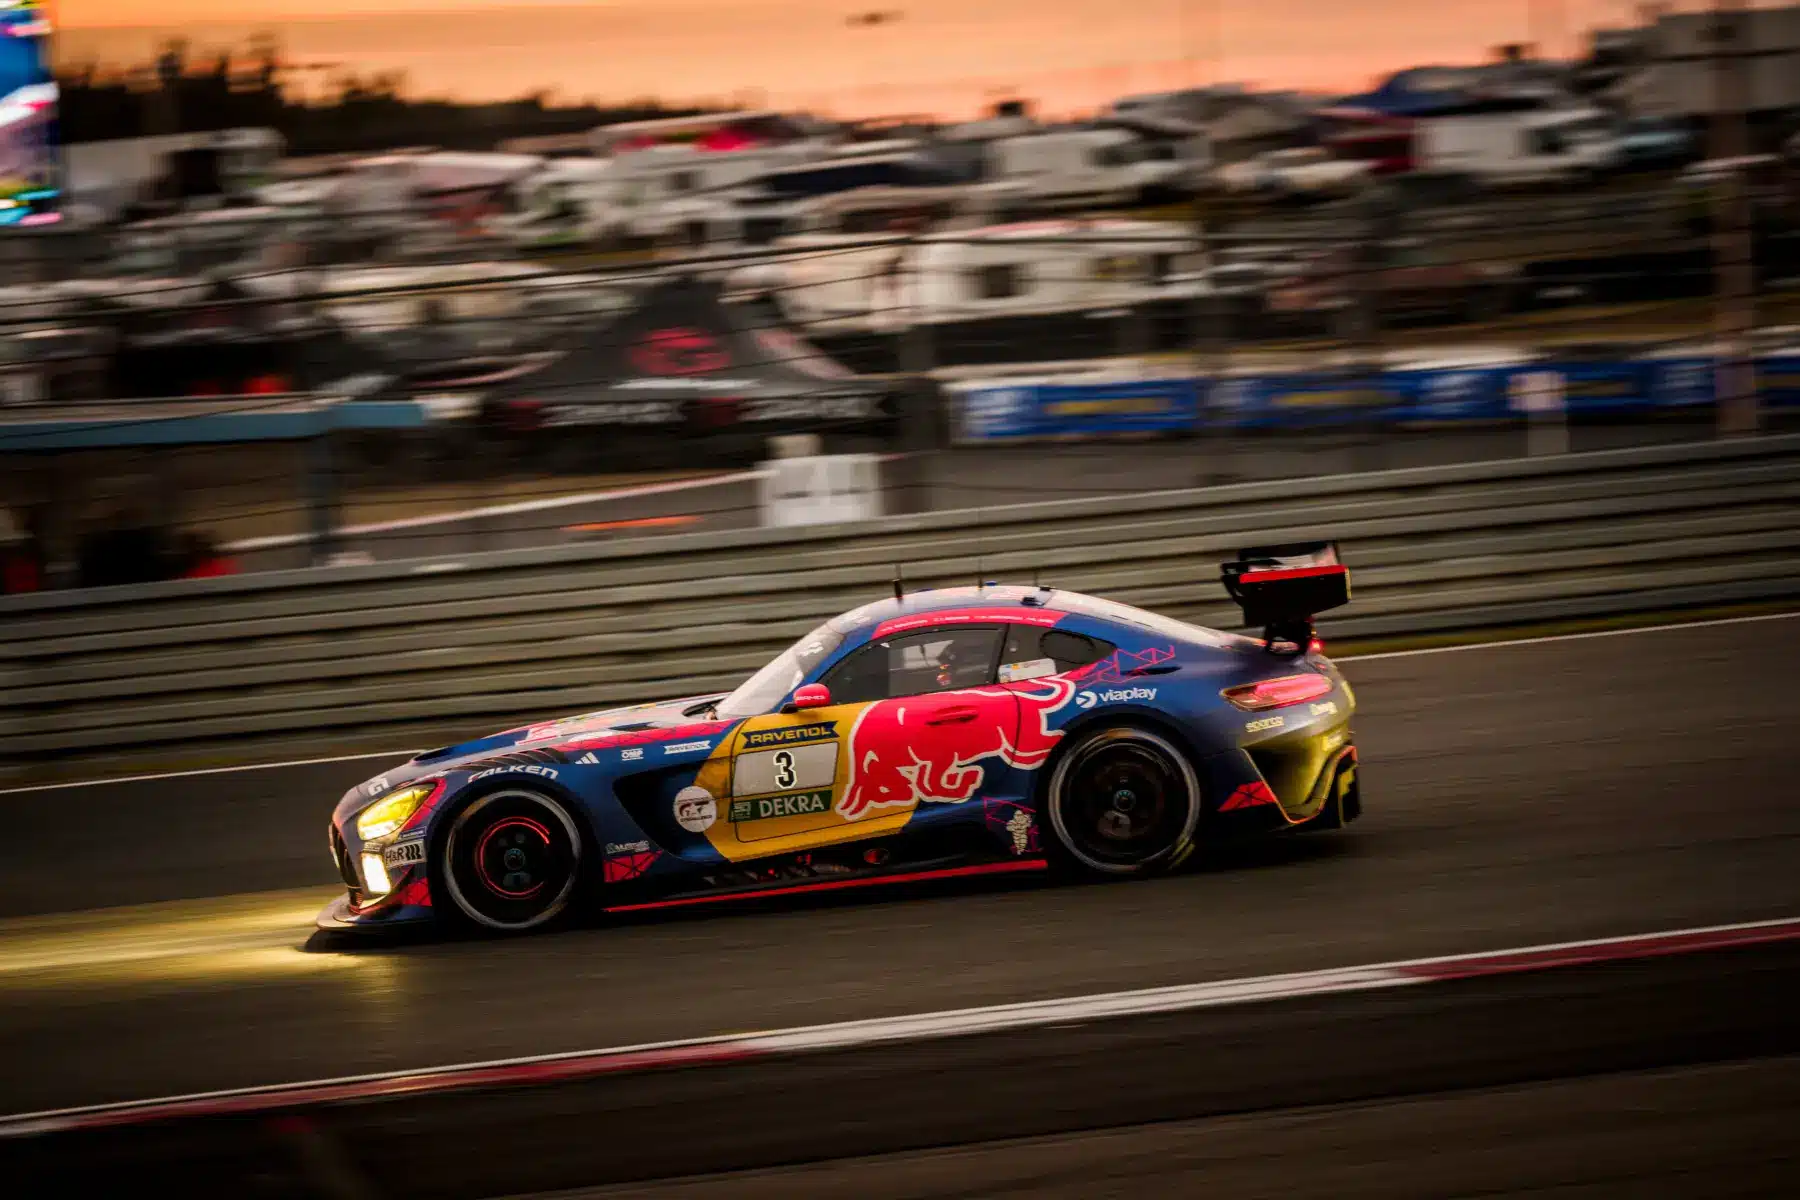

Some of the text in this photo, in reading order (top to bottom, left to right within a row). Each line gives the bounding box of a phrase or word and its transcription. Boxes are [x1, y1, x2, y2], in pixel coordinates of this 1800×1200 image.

[1099, 686, 1157, 703] viaplay
[1246, 717, 1283, 732] sparco
[750, 726, 832, 744] RAVENOL
[468, 765, 559, 783] FALKEN
[773, 750, 797, 789] 3
[760, 794, 824, 818] DEKRA
